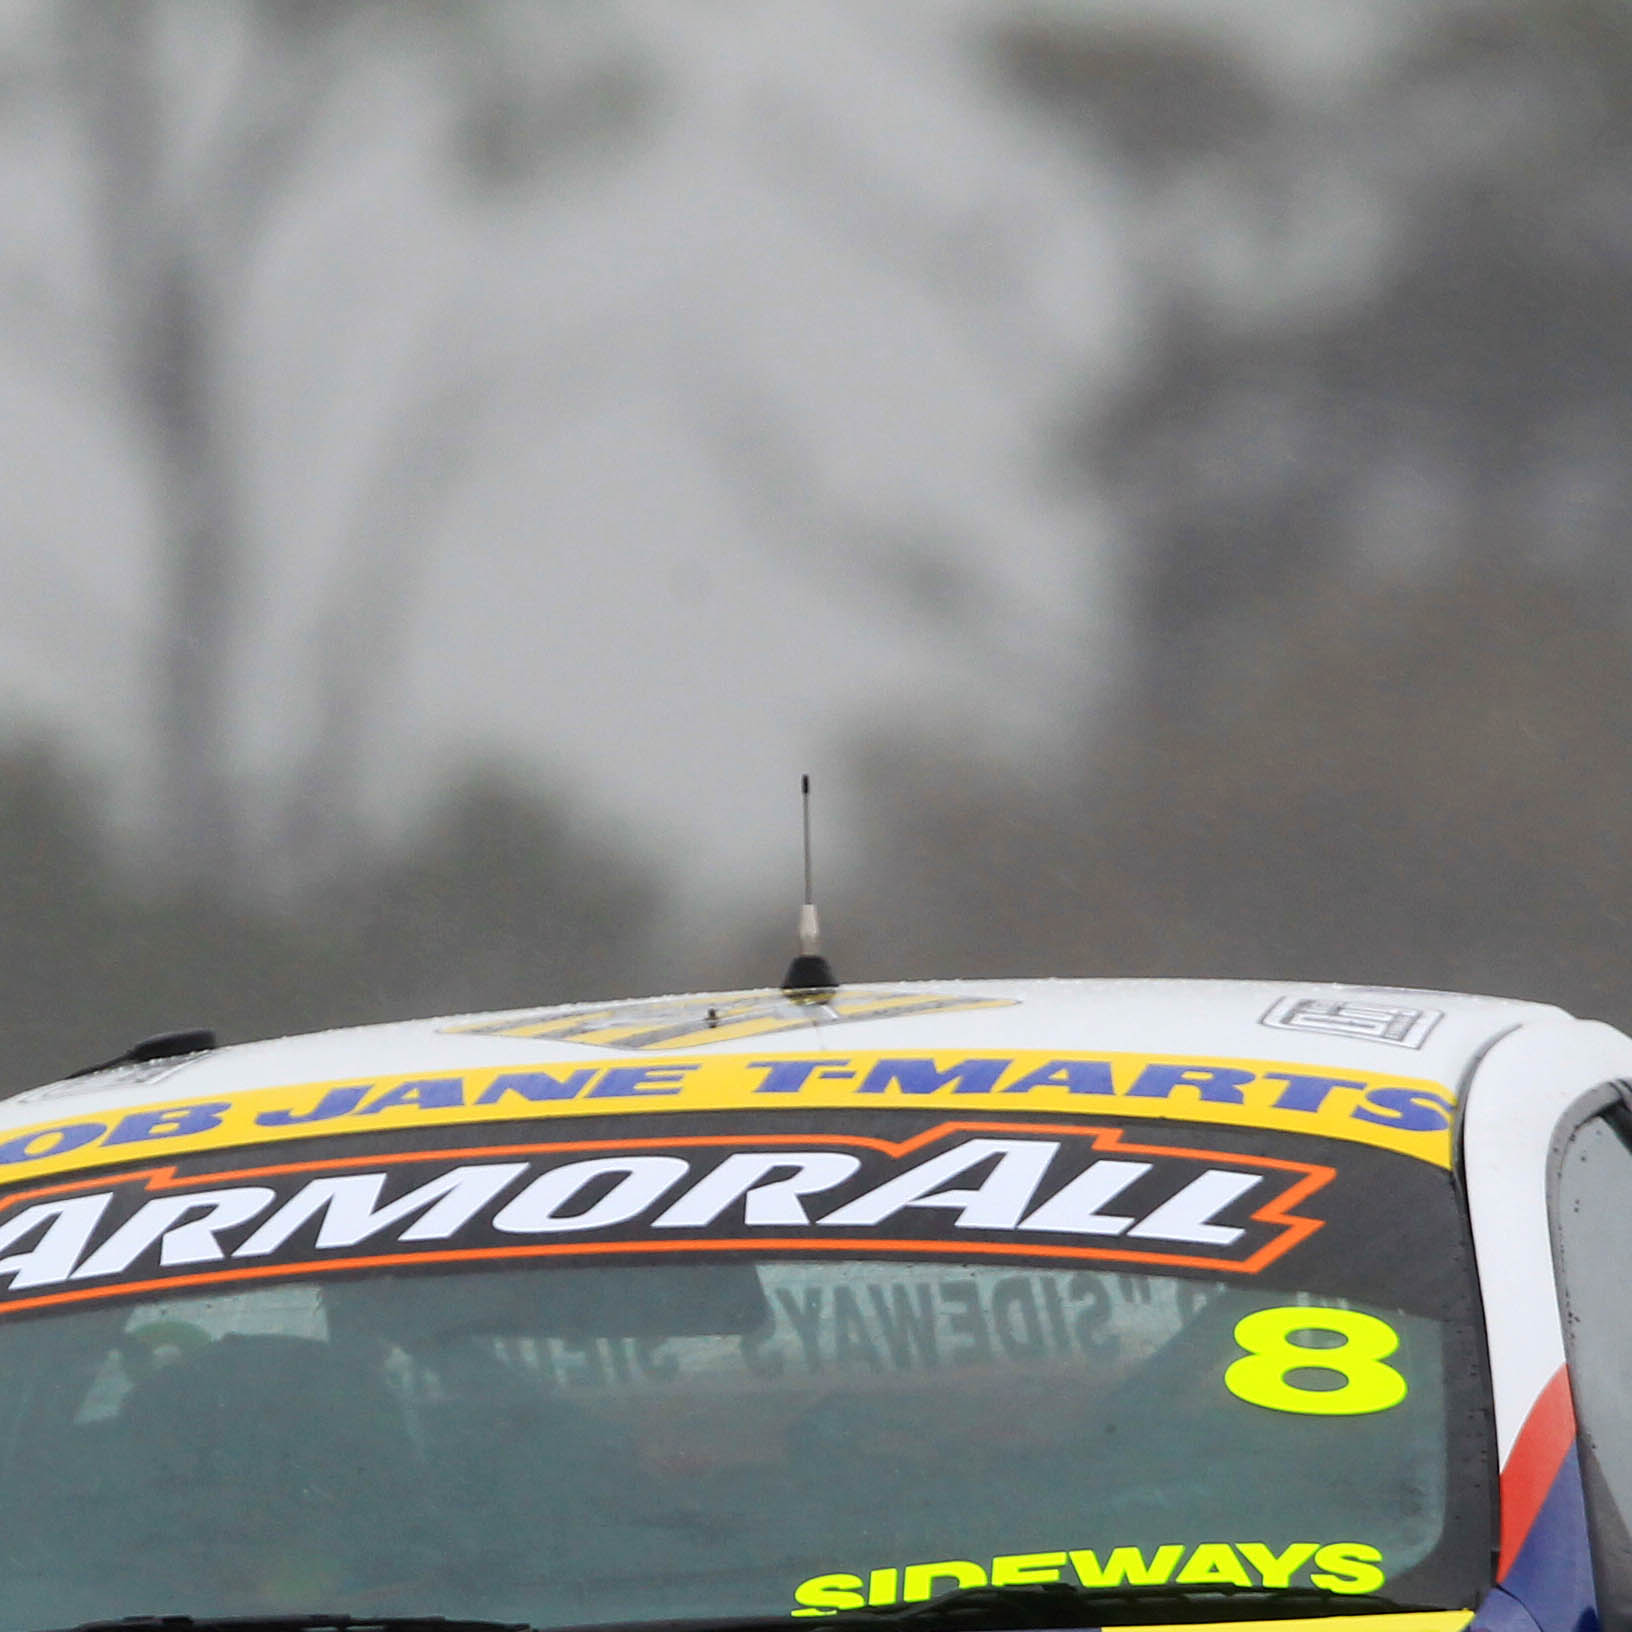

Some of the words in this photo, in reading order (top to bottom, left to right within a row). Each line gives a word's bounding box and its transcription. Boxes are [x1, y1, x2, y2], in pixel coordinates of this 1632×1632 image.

[253, 1063, 697, 1127] JANE
[749, 1058, 1455, 1132] T-MARTS
[1224, 1307, 1408, 1415] 8
[791, 1542, 1385, 1618] SIDEWAYS
